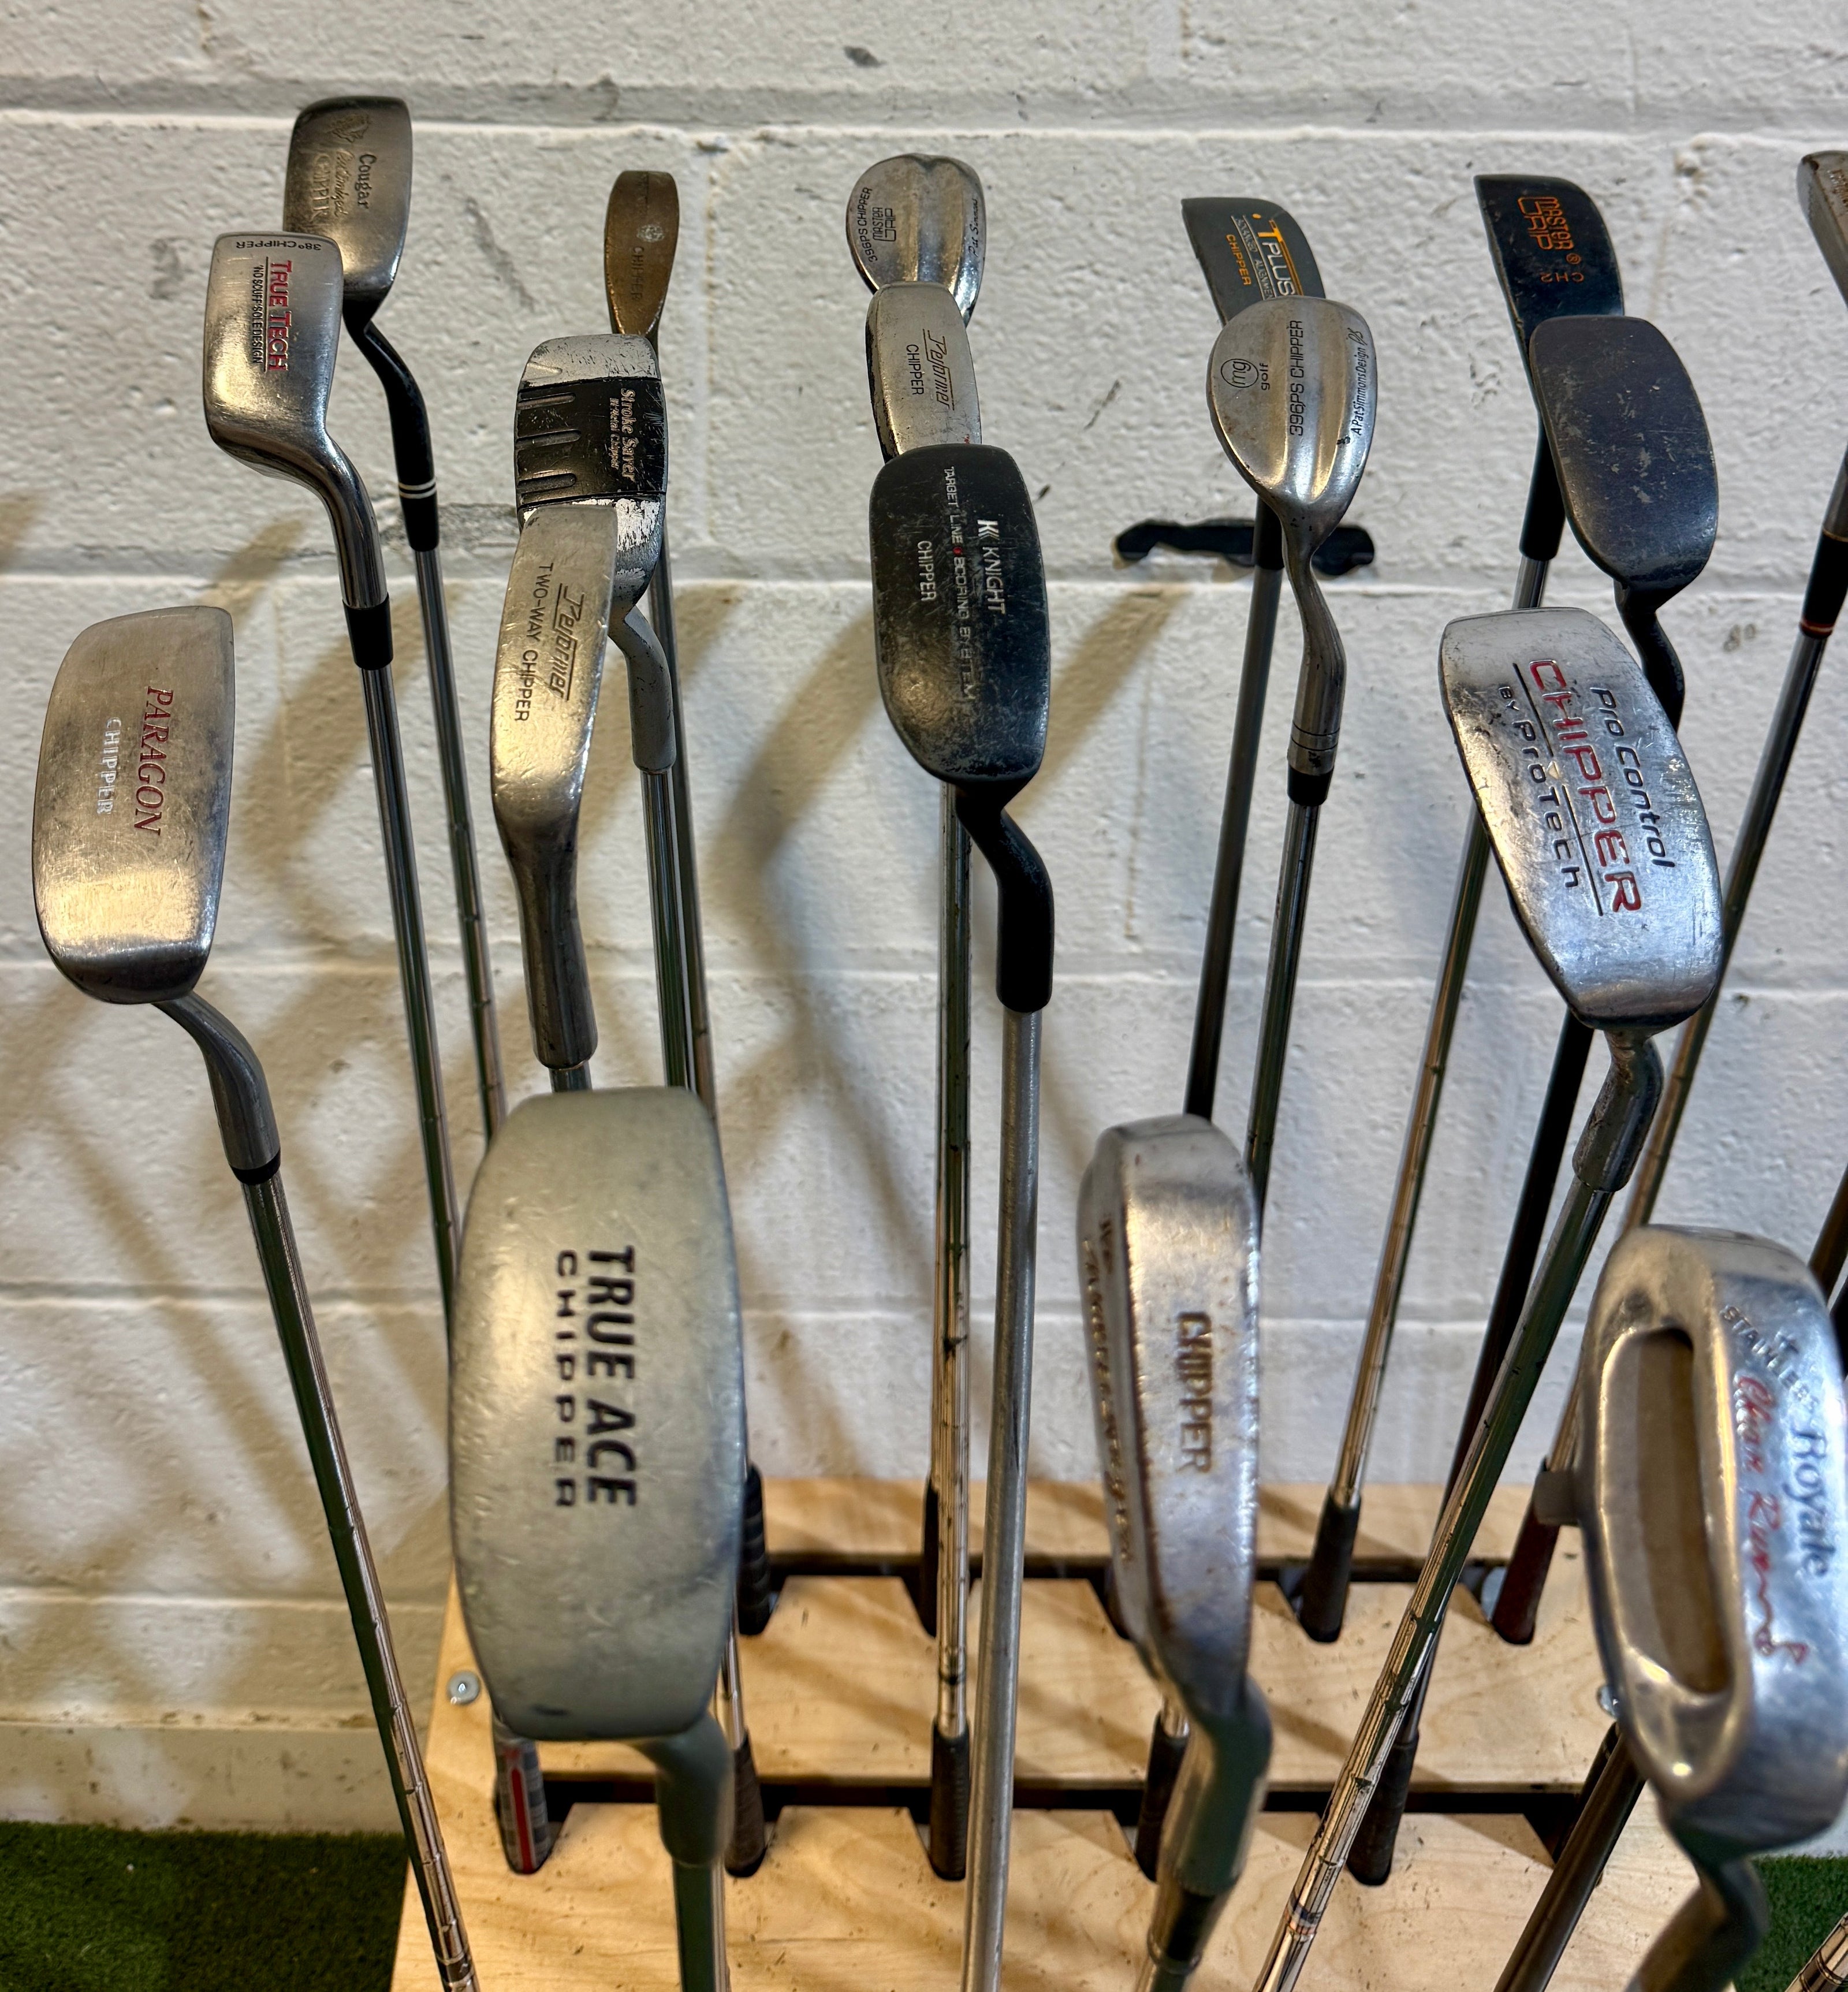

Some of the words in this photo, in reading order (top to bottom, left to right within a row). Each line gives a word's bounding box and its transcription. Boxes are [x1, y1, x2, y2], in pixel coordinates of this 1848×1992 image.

[312, 153, 331, 221] CHIPPER
[355, 154, 377, 209] Cougar
[858, 187, 873, 226] CHIPPER
[631, 246, 644, 300] CHIPPER
[860, 229, 878, 262] 396PS
[1226, 234, 1251, 286] CHIPPER
[269, 260, 292, 307] TRUE
[1541, 272, 1584, 283] CH2
[269, 311, 292, 371] TECH
[906, 344, 924, 395] CHIPPER
[923, 329, 955, 411] Performer
[1290, 321, 1304, 378] CHIPPER
[1260, 363, 1270, 390] golf
[621, 388, 636, 434] Stroke
[1290, 383, 1306, 435] 396PS
[621, 436, 639, 482] Saver
[944, 466, 959, 508] TARGET
[949, 515, 964, 544] LINE
[918, 541, 937, 602] CHIPPER
[954, 557, 970, 620] SCORING
[982, 546, 1005, 615] KNIGHT
[526, 563, 554, 642] TWO-WAY
[515, 650, 538, 721] CHIPPER
[96, 717, 122, 816] CHIPPER
[134, 686, 173, 836] PARAGON
[1529, 659, 1642, 913] CHIPPER
[587, 1244, 636, 1379] TRUE
[555, 1250, 578, 1507] CHIPPER
[1176, 1310, 1213, 1474] CHIPPER
[586, 1398, 638, 1507] ACE
